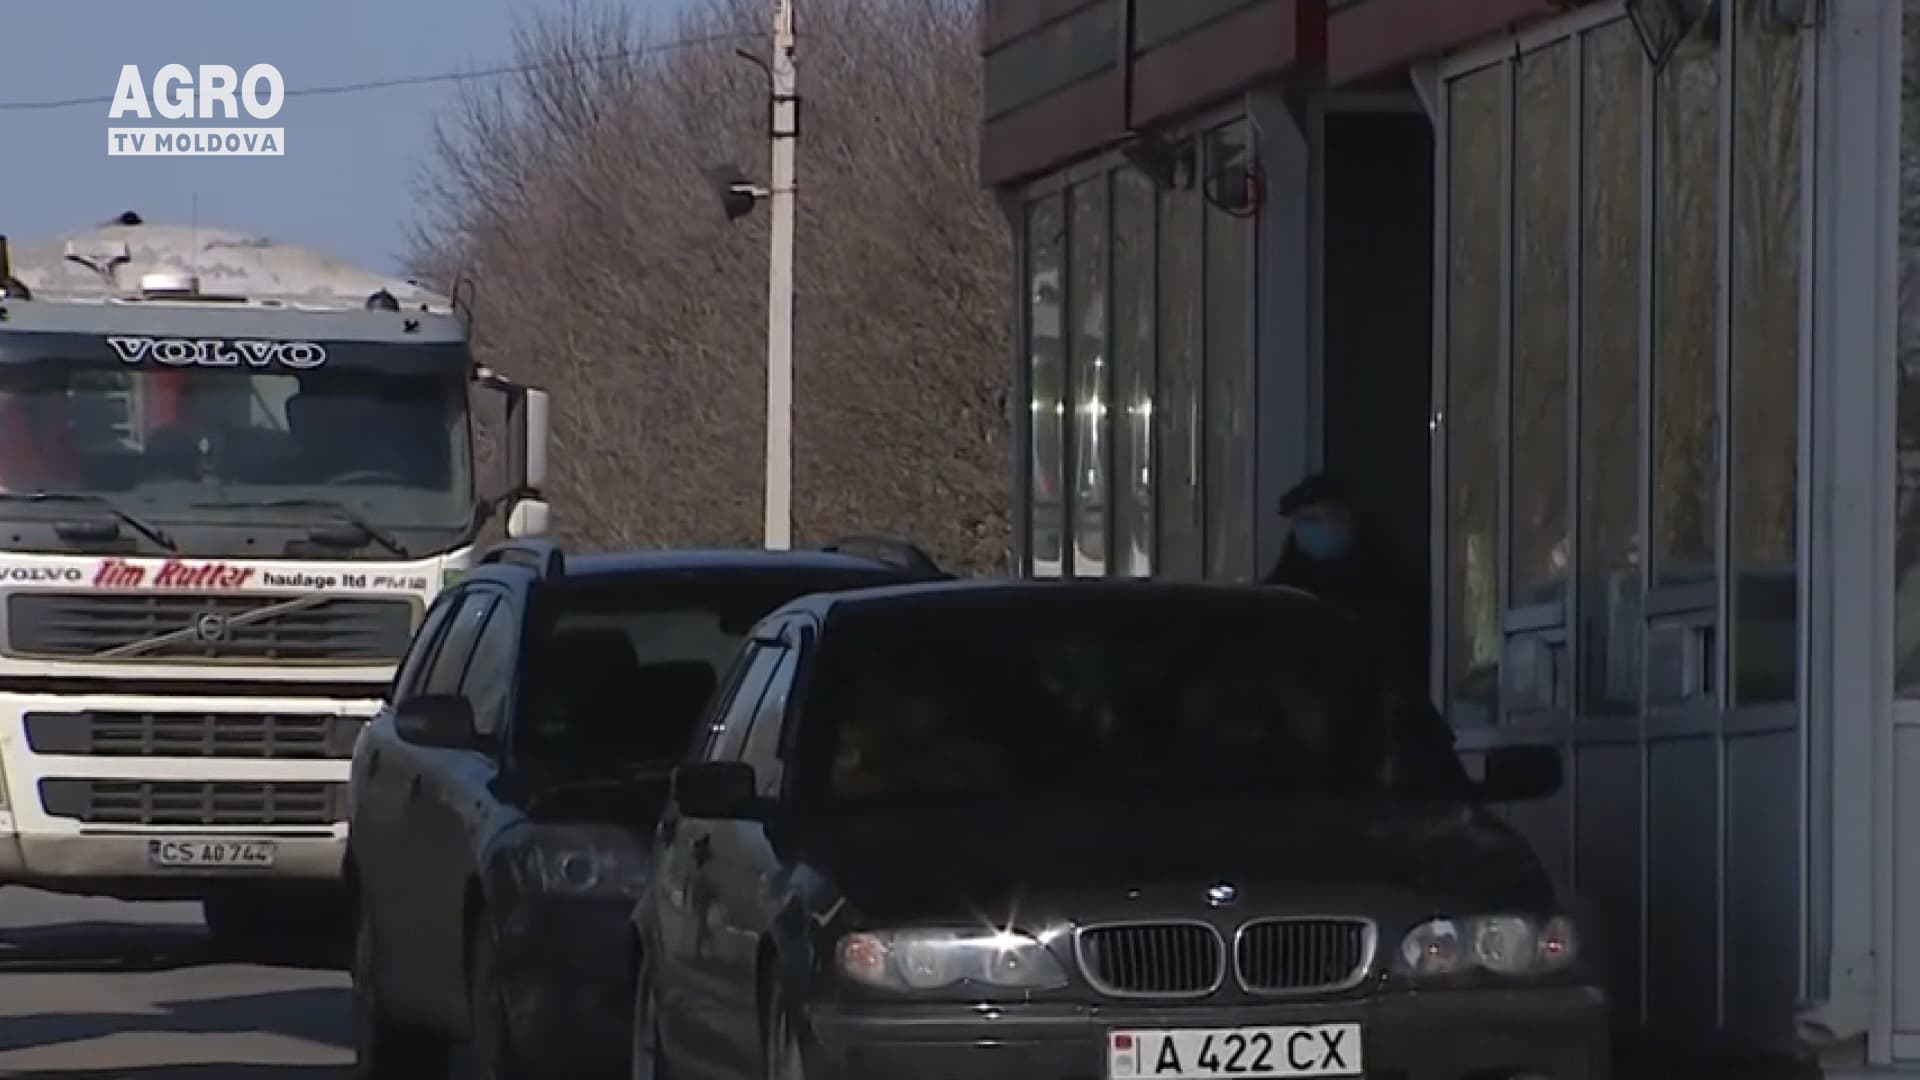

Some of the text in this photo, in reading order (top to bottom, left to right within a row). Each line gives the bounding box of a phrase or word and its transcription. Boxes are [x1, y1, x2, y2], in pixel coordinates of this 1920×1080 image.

[106, 336, 327, 369] VOLVO
[263, 572, 366, 589] haulage ltd
[162, 843, 194, 861] CS
[1155, 1029, 1346, 1073] A 422 CX
